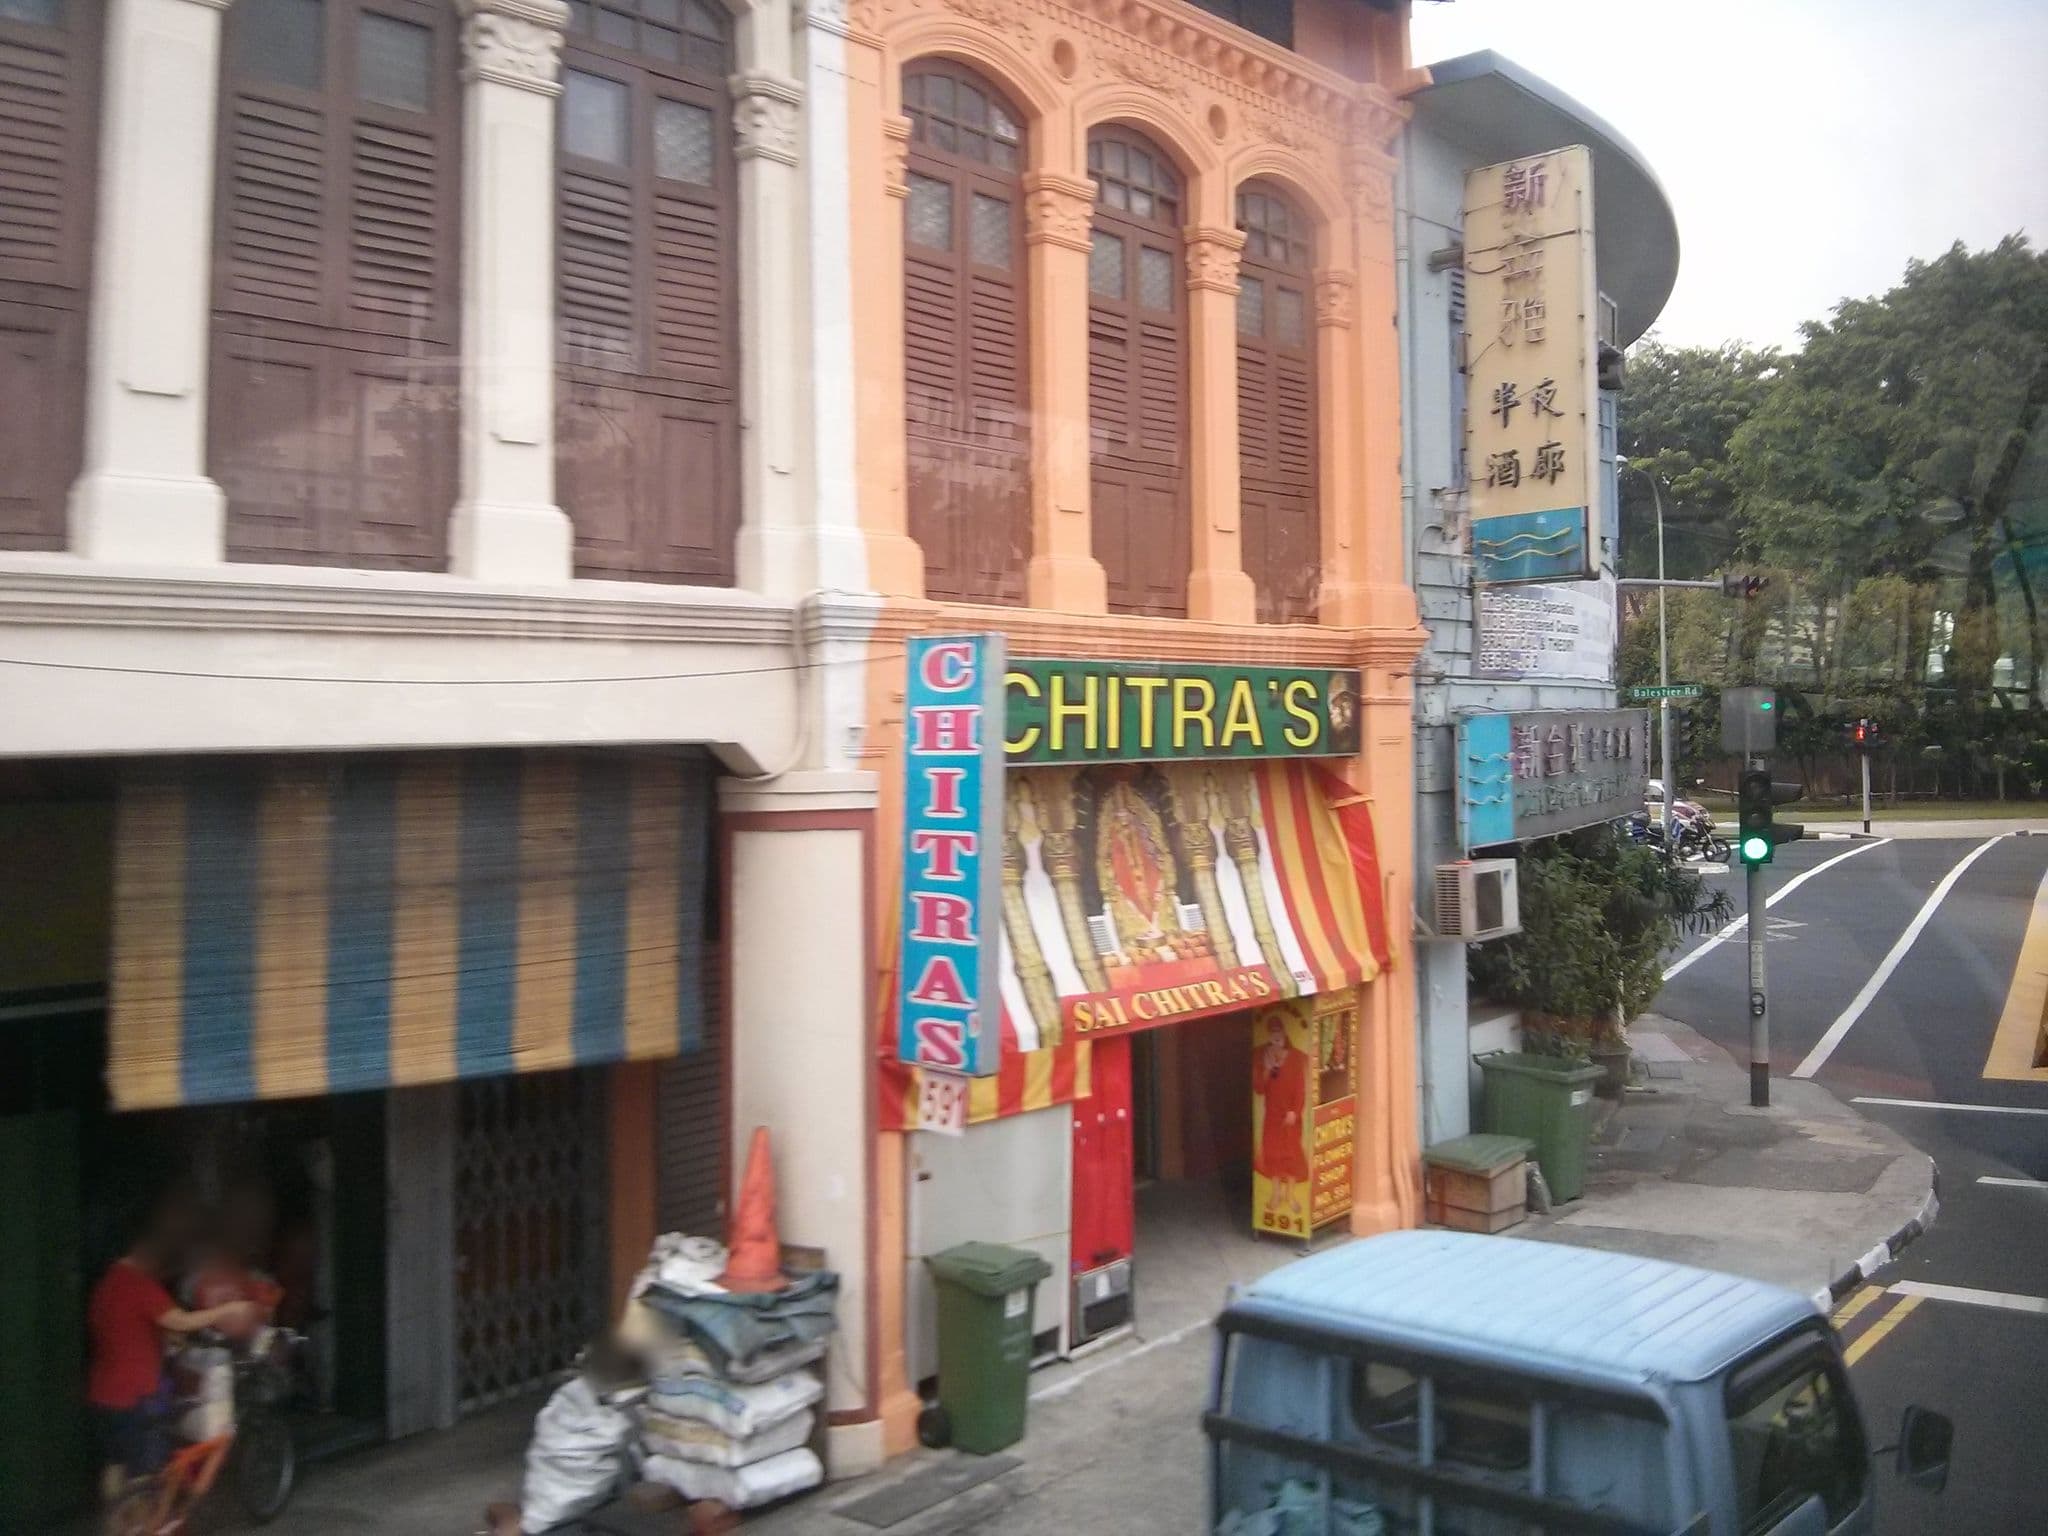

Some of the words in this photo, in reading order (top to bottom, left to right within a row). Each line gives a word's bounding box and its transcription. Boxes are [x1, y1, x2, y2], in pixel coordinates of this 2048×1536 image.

[1491, 377, 1565, 429] 半夜
[1486, 440, 1566, 489] 酒廊
[1503, 593, 1541, 612] Science
[1481, 633, 1537, 651] PRACTICAL
[1633, 688, 1682, 698] Balestier
[1684, 686, 1698, 696] Rd
[1001, 671, 1320, 755] CHITRA'S
[1072, 995, 1131, 1033] SAI
[1131, 970, 1271, 1021] CHITRA'S
[1262, 1210, 1304, 1233] 591
